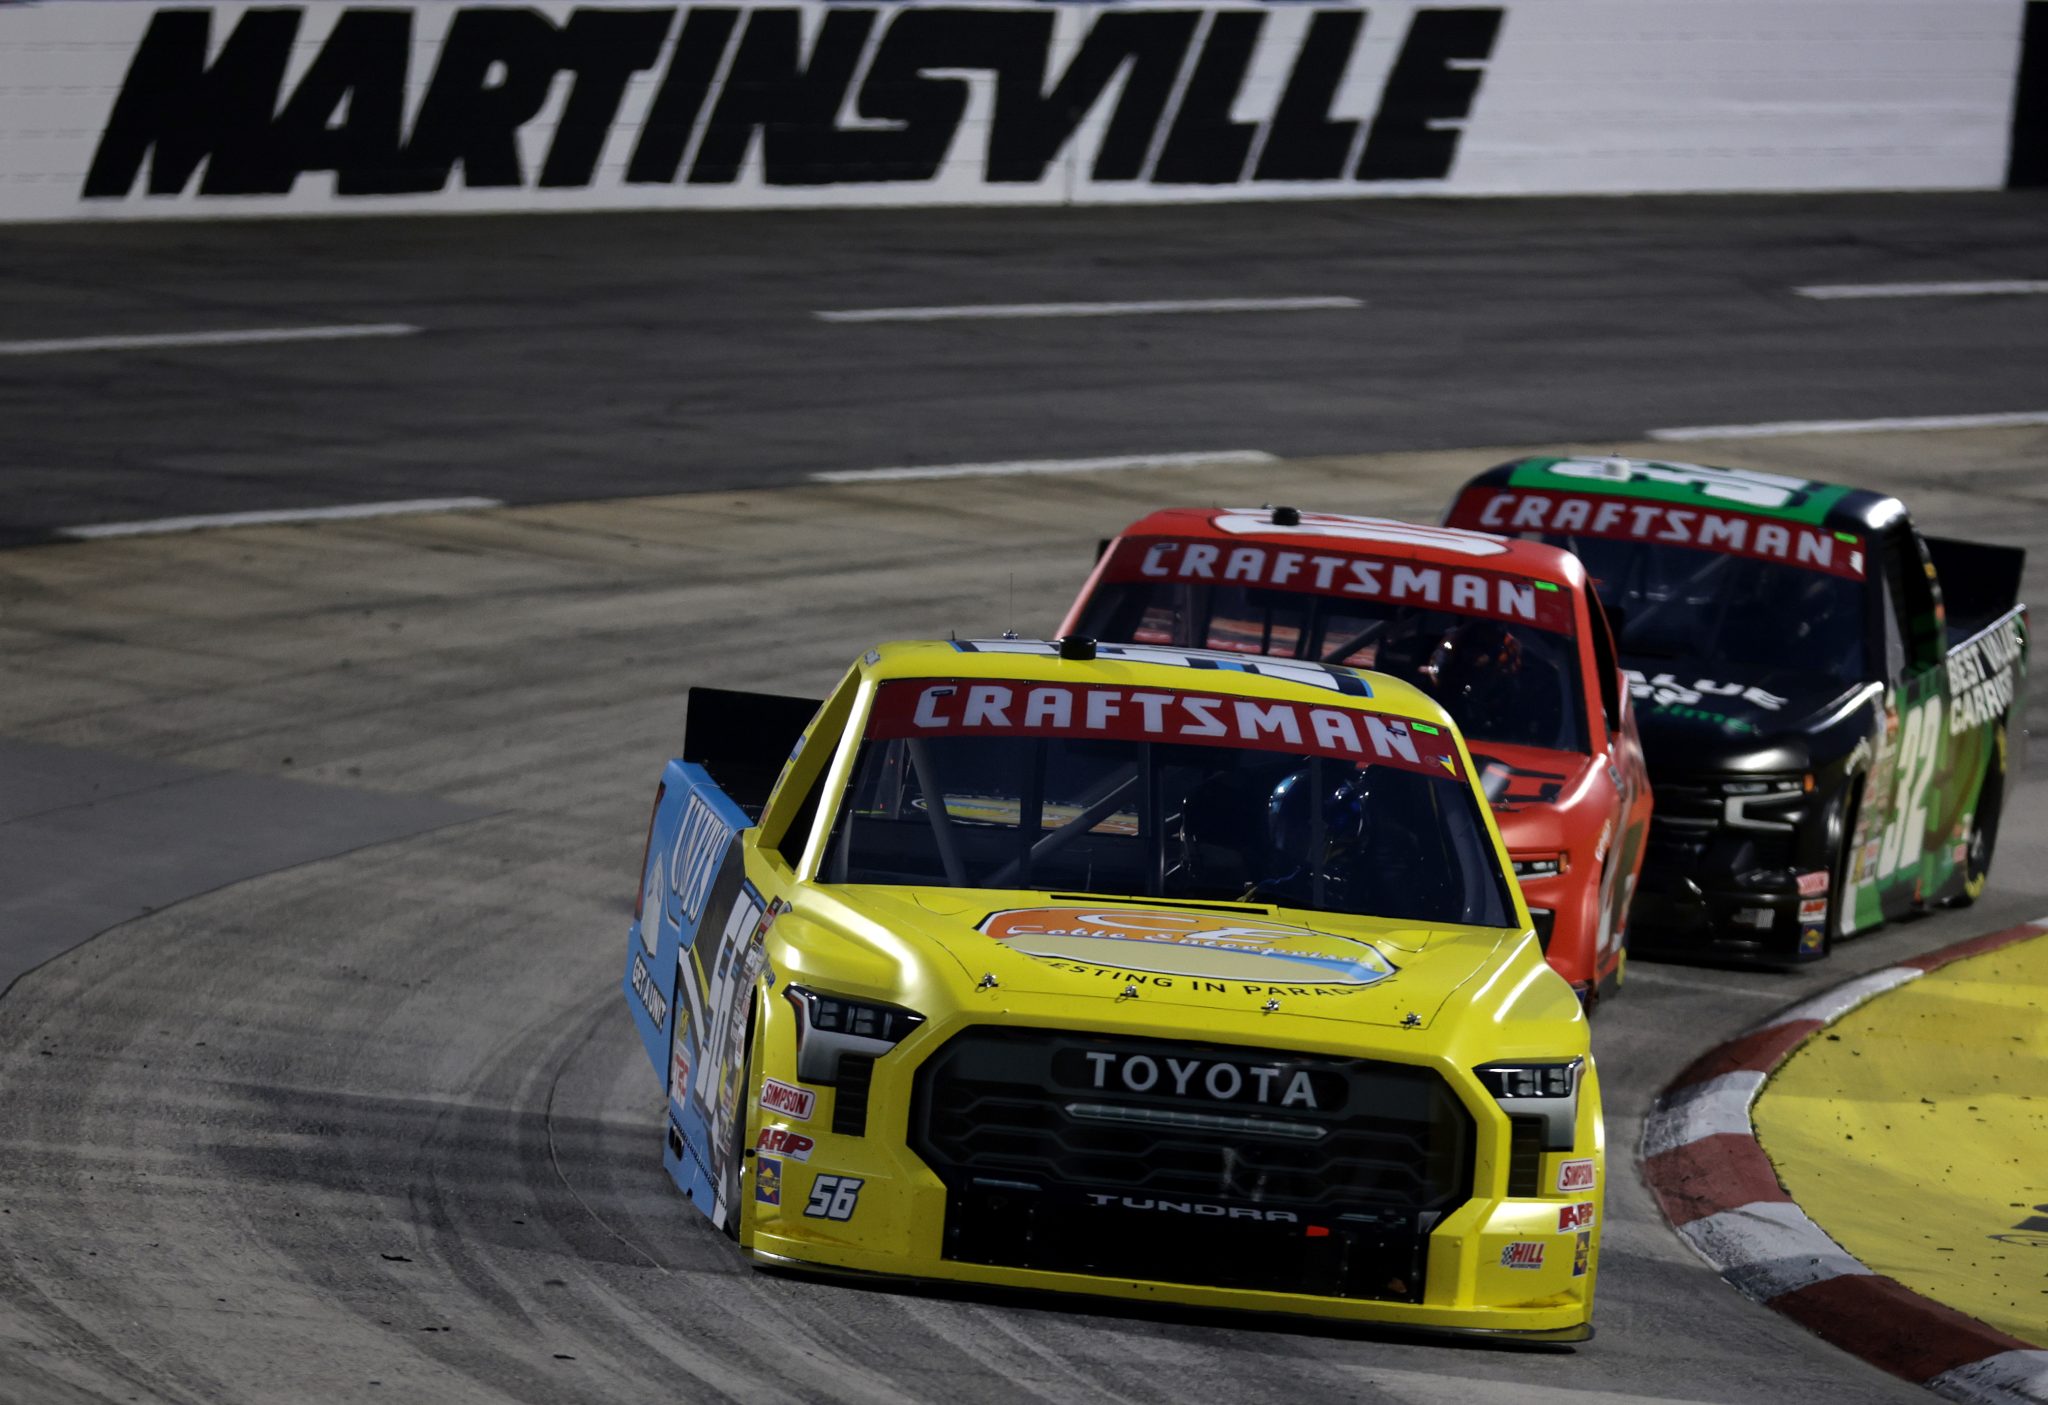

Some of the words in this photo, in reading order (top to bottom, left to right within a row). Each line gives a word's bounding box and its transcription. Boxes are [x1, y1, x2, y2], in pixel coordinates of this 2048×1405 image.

[81, 6, 1506, 198] MARTINSVILLE
[1480, 494, 1834, 568] CRAFTSMAN
[1140, 542, 1537, 620] CRAFTSMAN
[912, 684, 1421, 765] CRAFTSMAN
[1876, 695, 1942, 880] 32
[1192, 980, 1227, 993] IN
[762, 1083, 809, 1115] SIMPSON
[1086, 1051, 1318, 1108] TOYOTA
[756, 1128, 814, 1154] ARP
[803, 1173, 864, 1221] 56
[1086, 1193, 1299, 1222] TUNDRA
[1511, 1242, 1545, 1263] HILL
